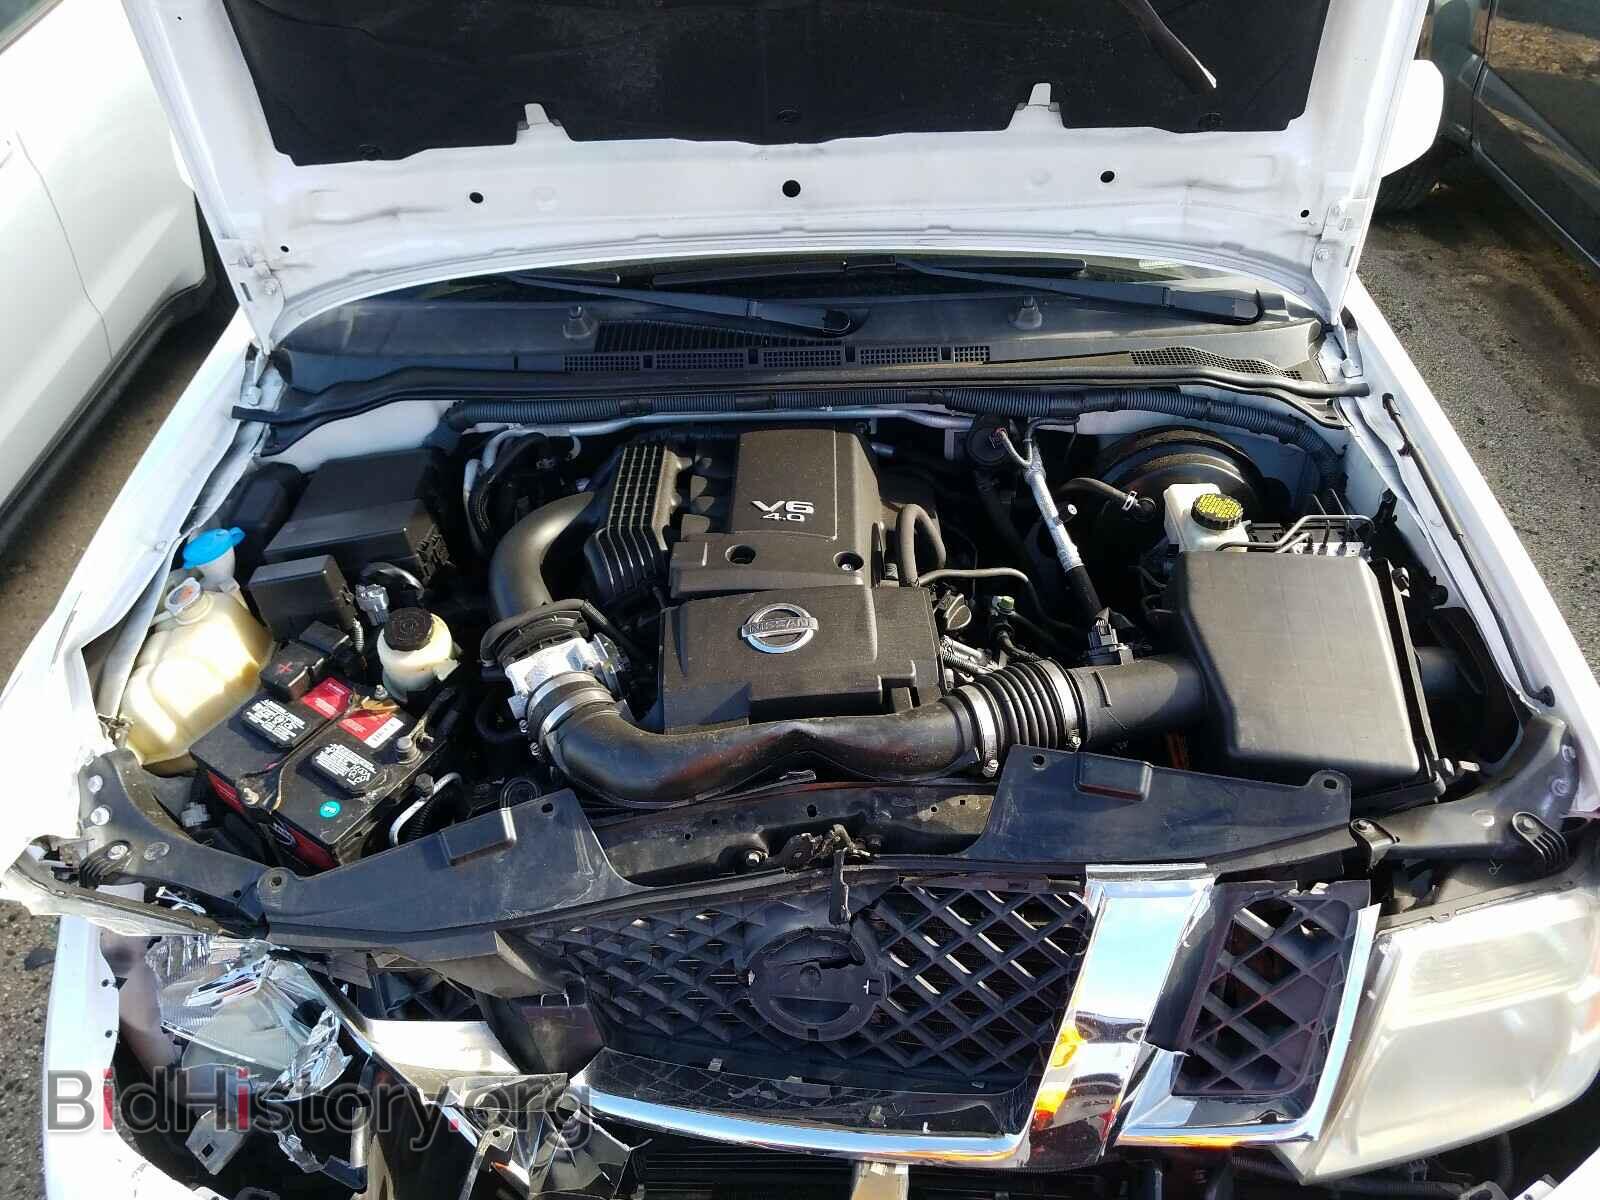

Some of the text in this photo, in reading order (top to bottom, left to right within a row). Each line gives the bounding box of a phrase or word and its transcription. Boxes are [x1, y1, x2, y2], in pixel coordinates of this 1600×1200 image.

[752, 500, 815, 515] V6
[762, 512, 806, 523] 4.0
[749, 616, 811, 633] NISSAN
